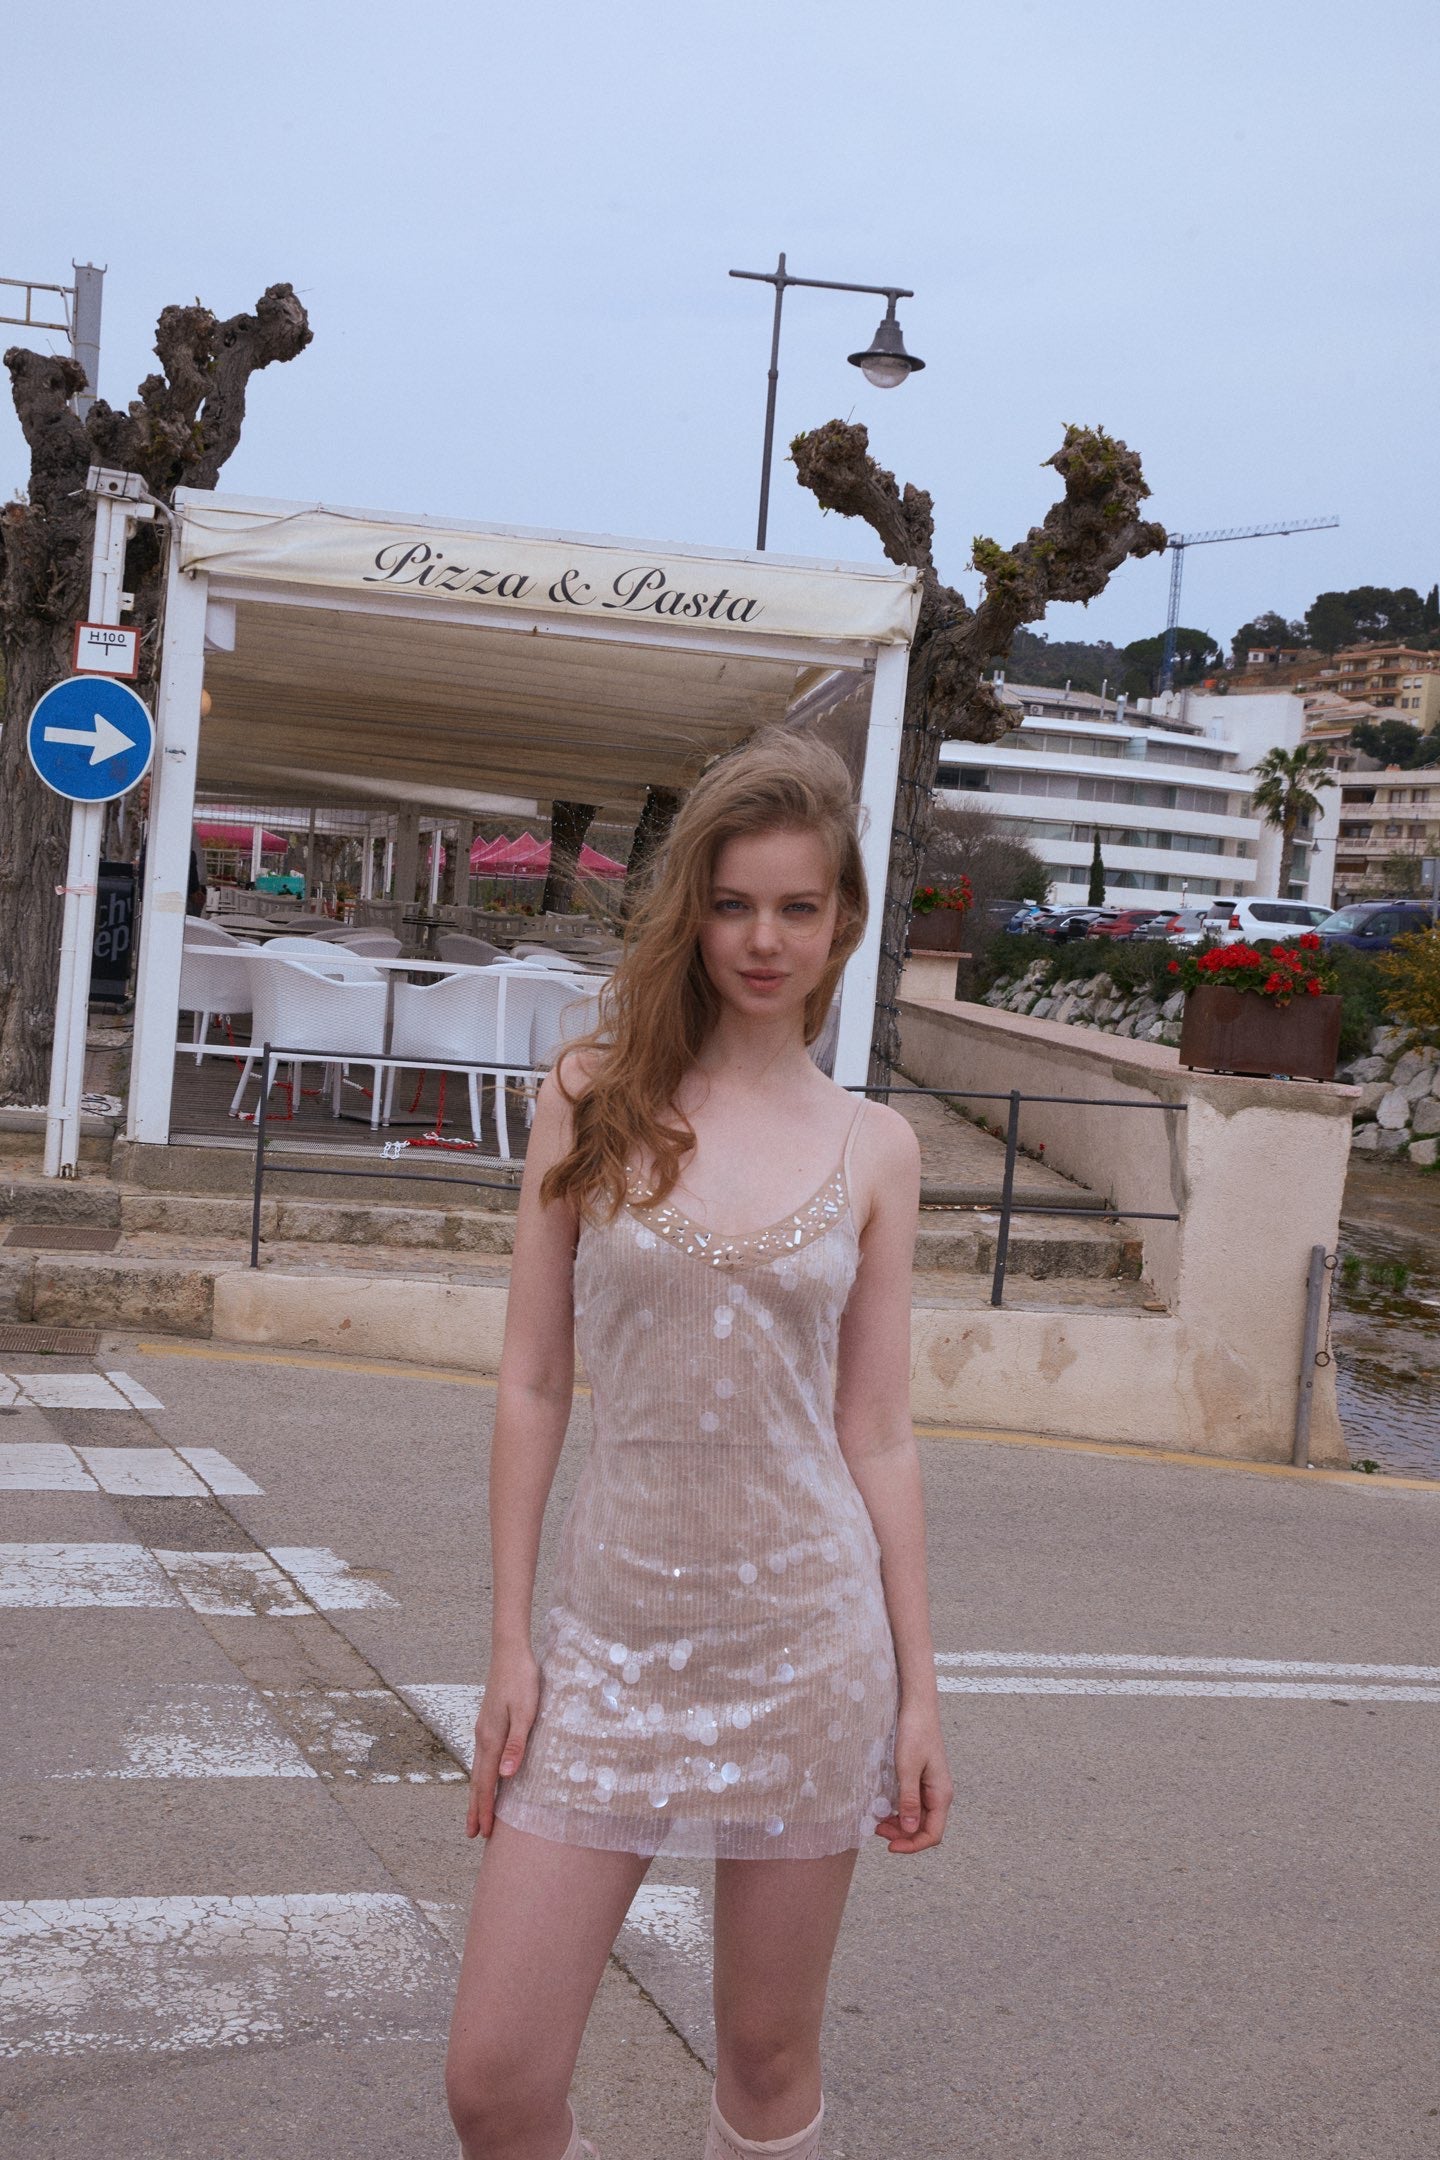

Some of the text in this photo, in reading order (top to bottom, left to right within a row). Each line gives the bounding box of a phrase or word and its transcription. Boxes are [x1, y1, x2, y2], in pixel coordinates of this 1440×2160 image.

[363, 541, 765, 623] Pizza & Pasta
[90, 631, 126, 643] H100
